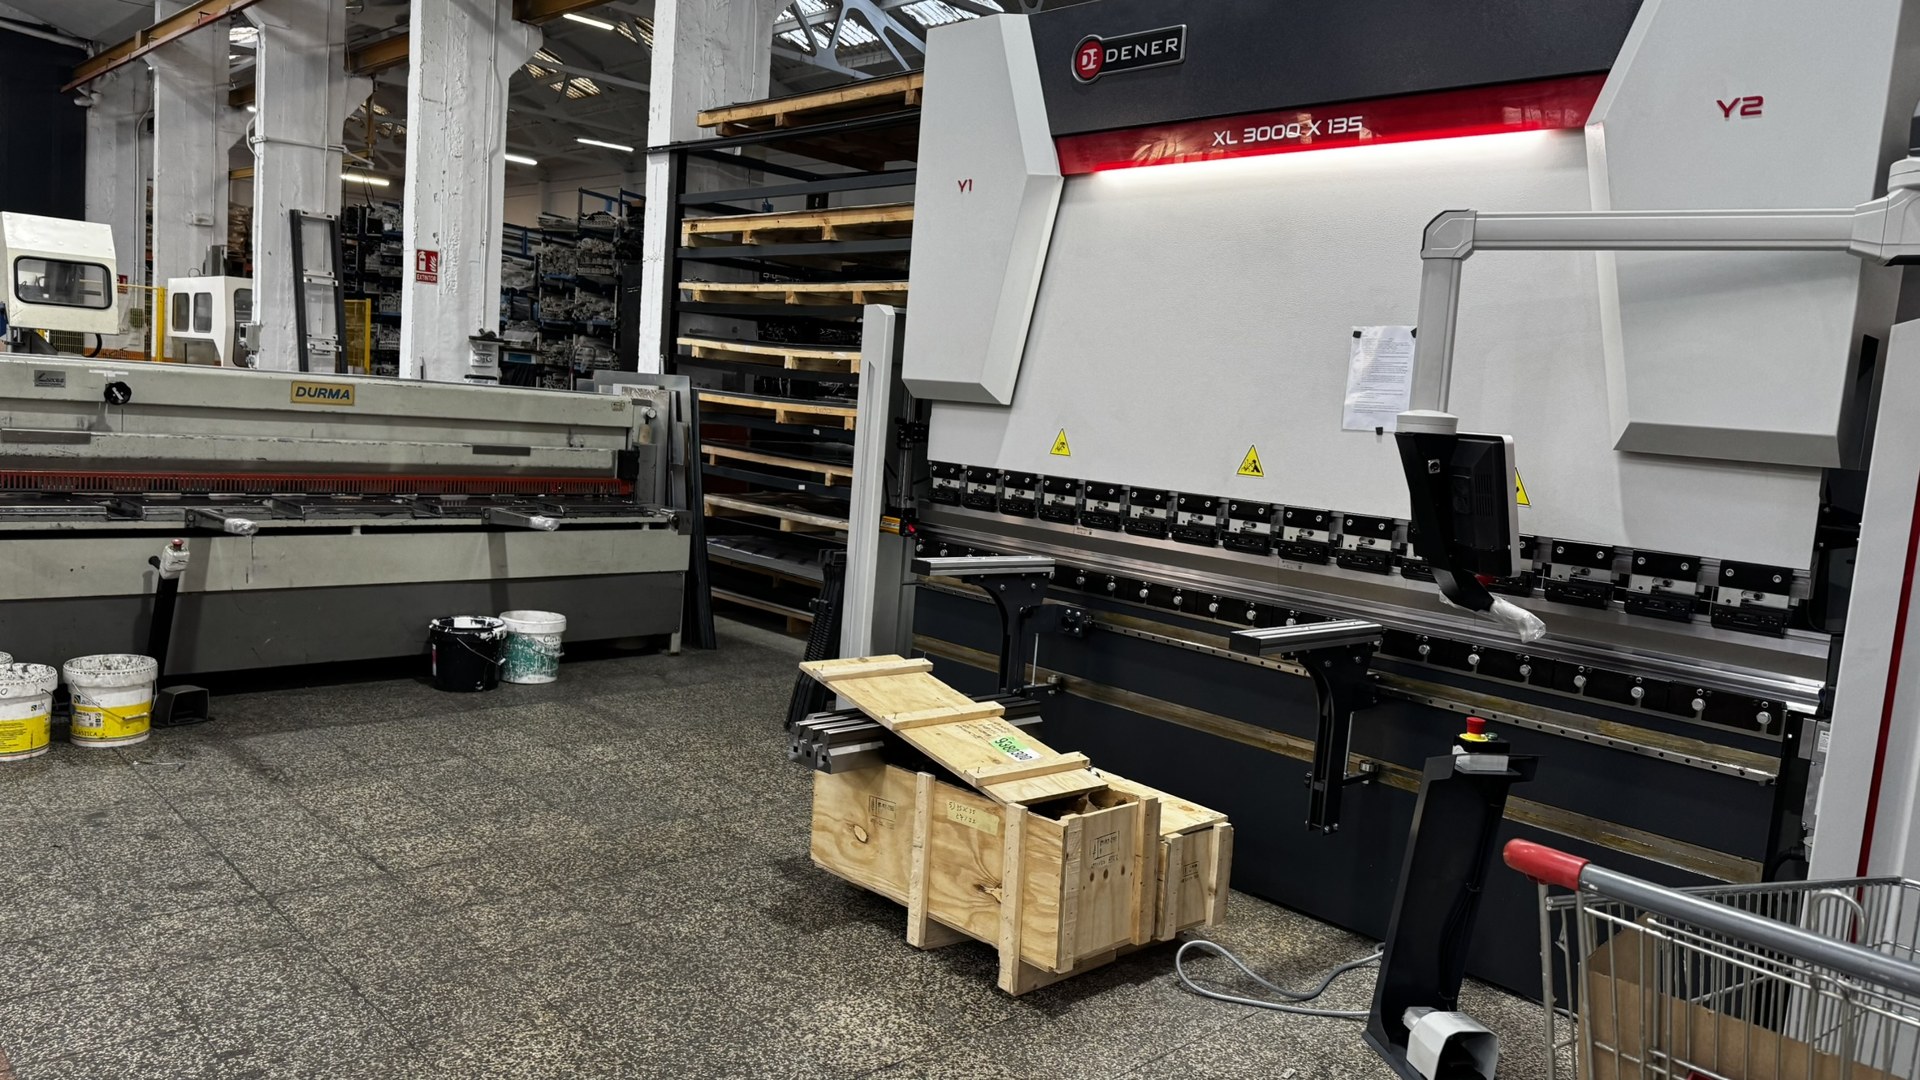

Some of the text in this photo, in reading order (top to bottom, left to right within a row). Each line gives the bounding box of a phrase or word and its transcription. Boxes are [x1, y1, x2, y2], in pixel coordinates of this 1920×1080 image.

[1105, 37, 1178, 63] DENER
[1716, 95, 1764, 118] Y2
[1212, 130, 1238, 151] XL
[1306, 120, 1322, 137] X
[1327, 115, 1363, 134] 135
[957, 178, 973, 193] Y1
[416, 273, 437, 282] EXTINTOR
[294, 386, 350, 400] DURMA
